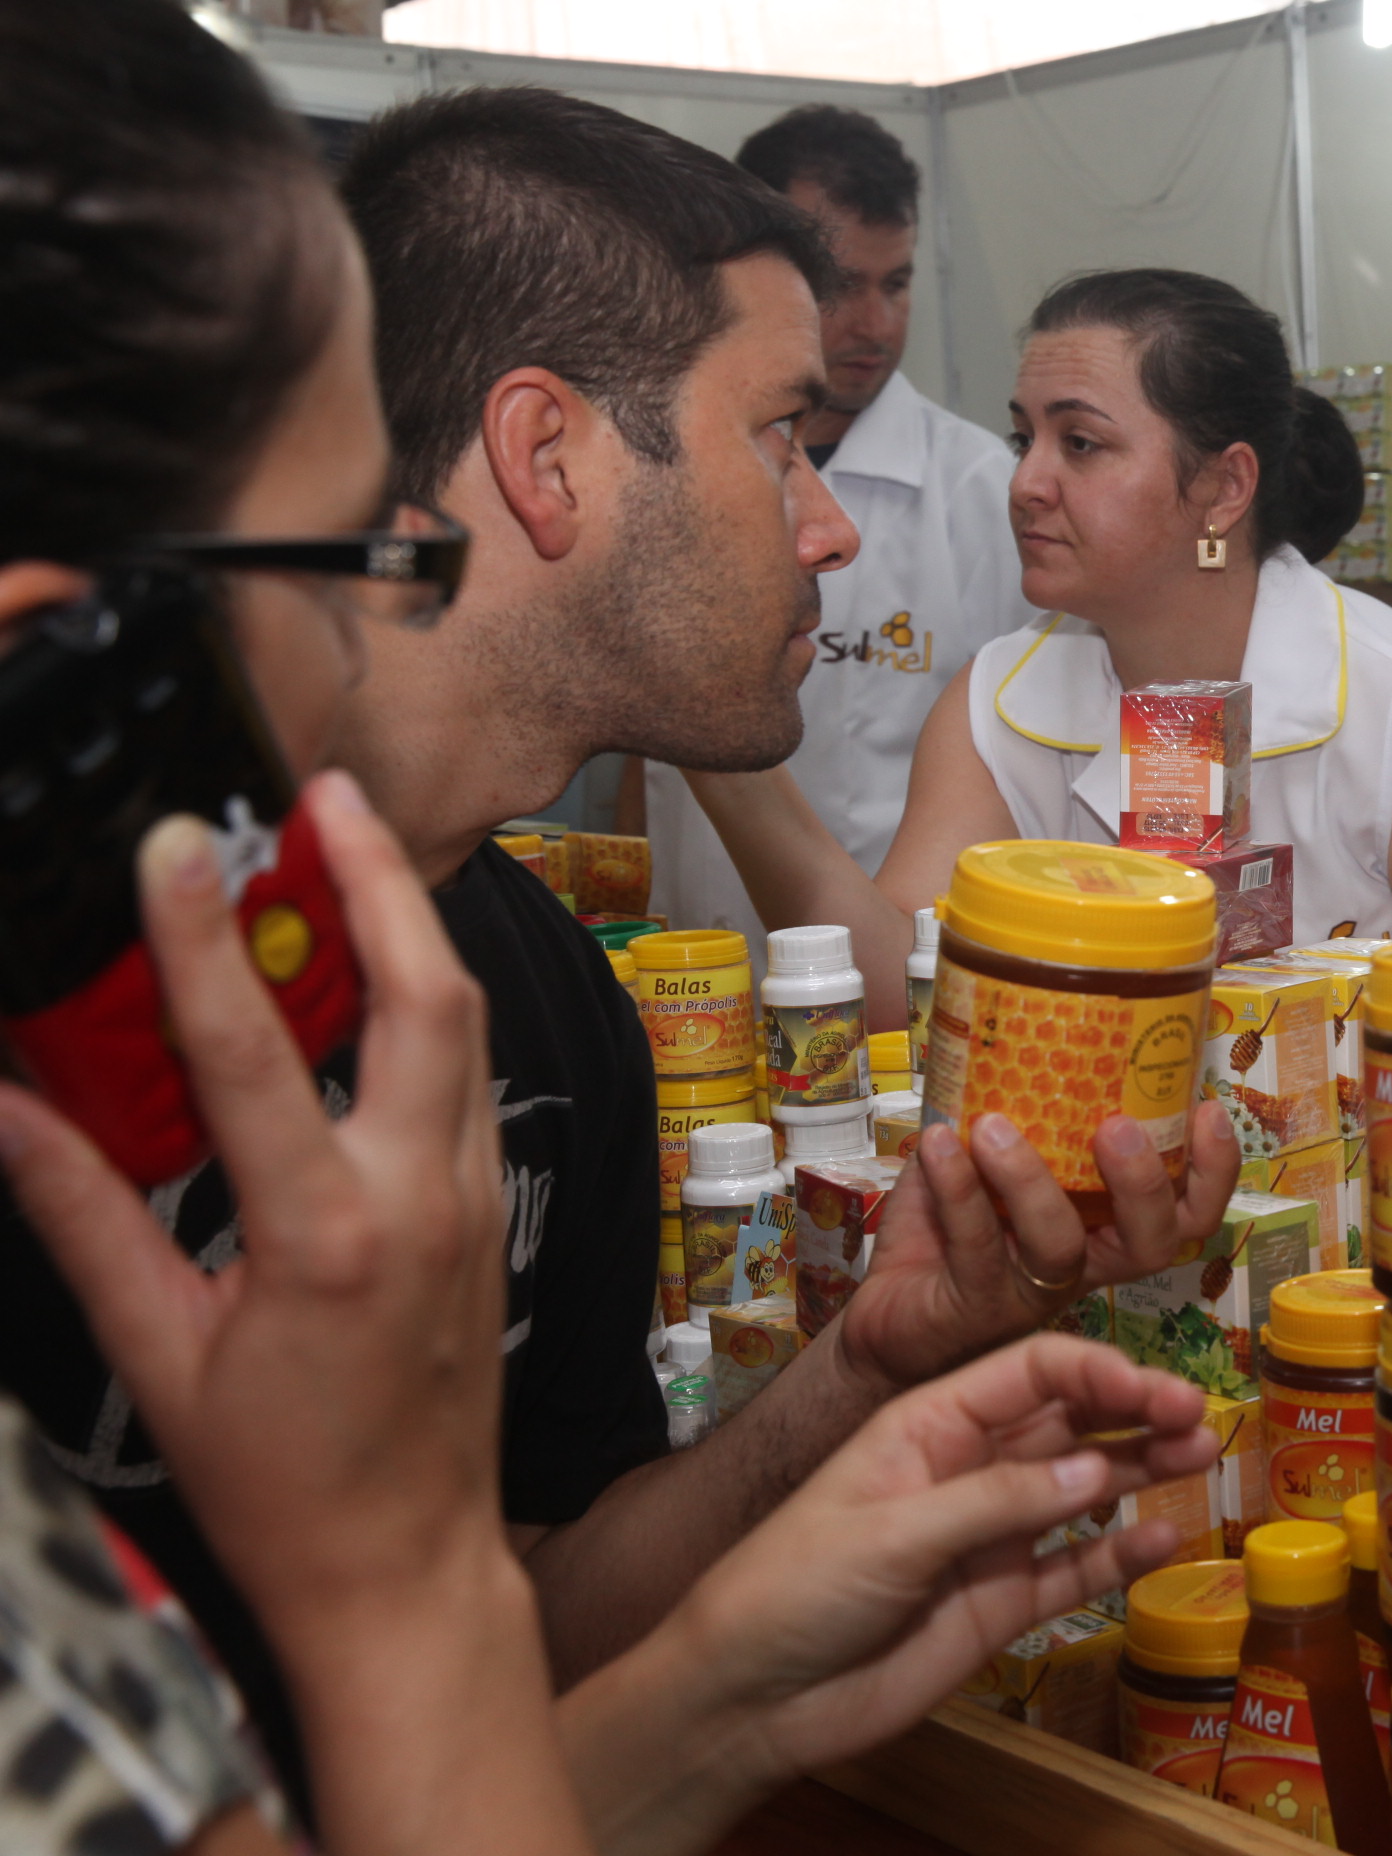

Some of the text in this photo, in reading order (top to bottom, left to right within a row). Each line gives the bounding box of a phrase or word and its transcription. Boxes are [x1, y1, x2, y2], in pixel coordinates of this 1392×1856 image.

[818, 630, 933, 673] Sulmel
[654, 977, 712, 997] Balas
[641, 996, 738, 1015] el com Própolis
[813, 1038, 843, 1053] BRASIL
[758, 1197, 797, 1240] UniSp
[1295, 1407, 1343, 1433] Mel
[1189, 1716, 1230, 1741] Me
[1240, 1695, 1295, 1737] Mel
